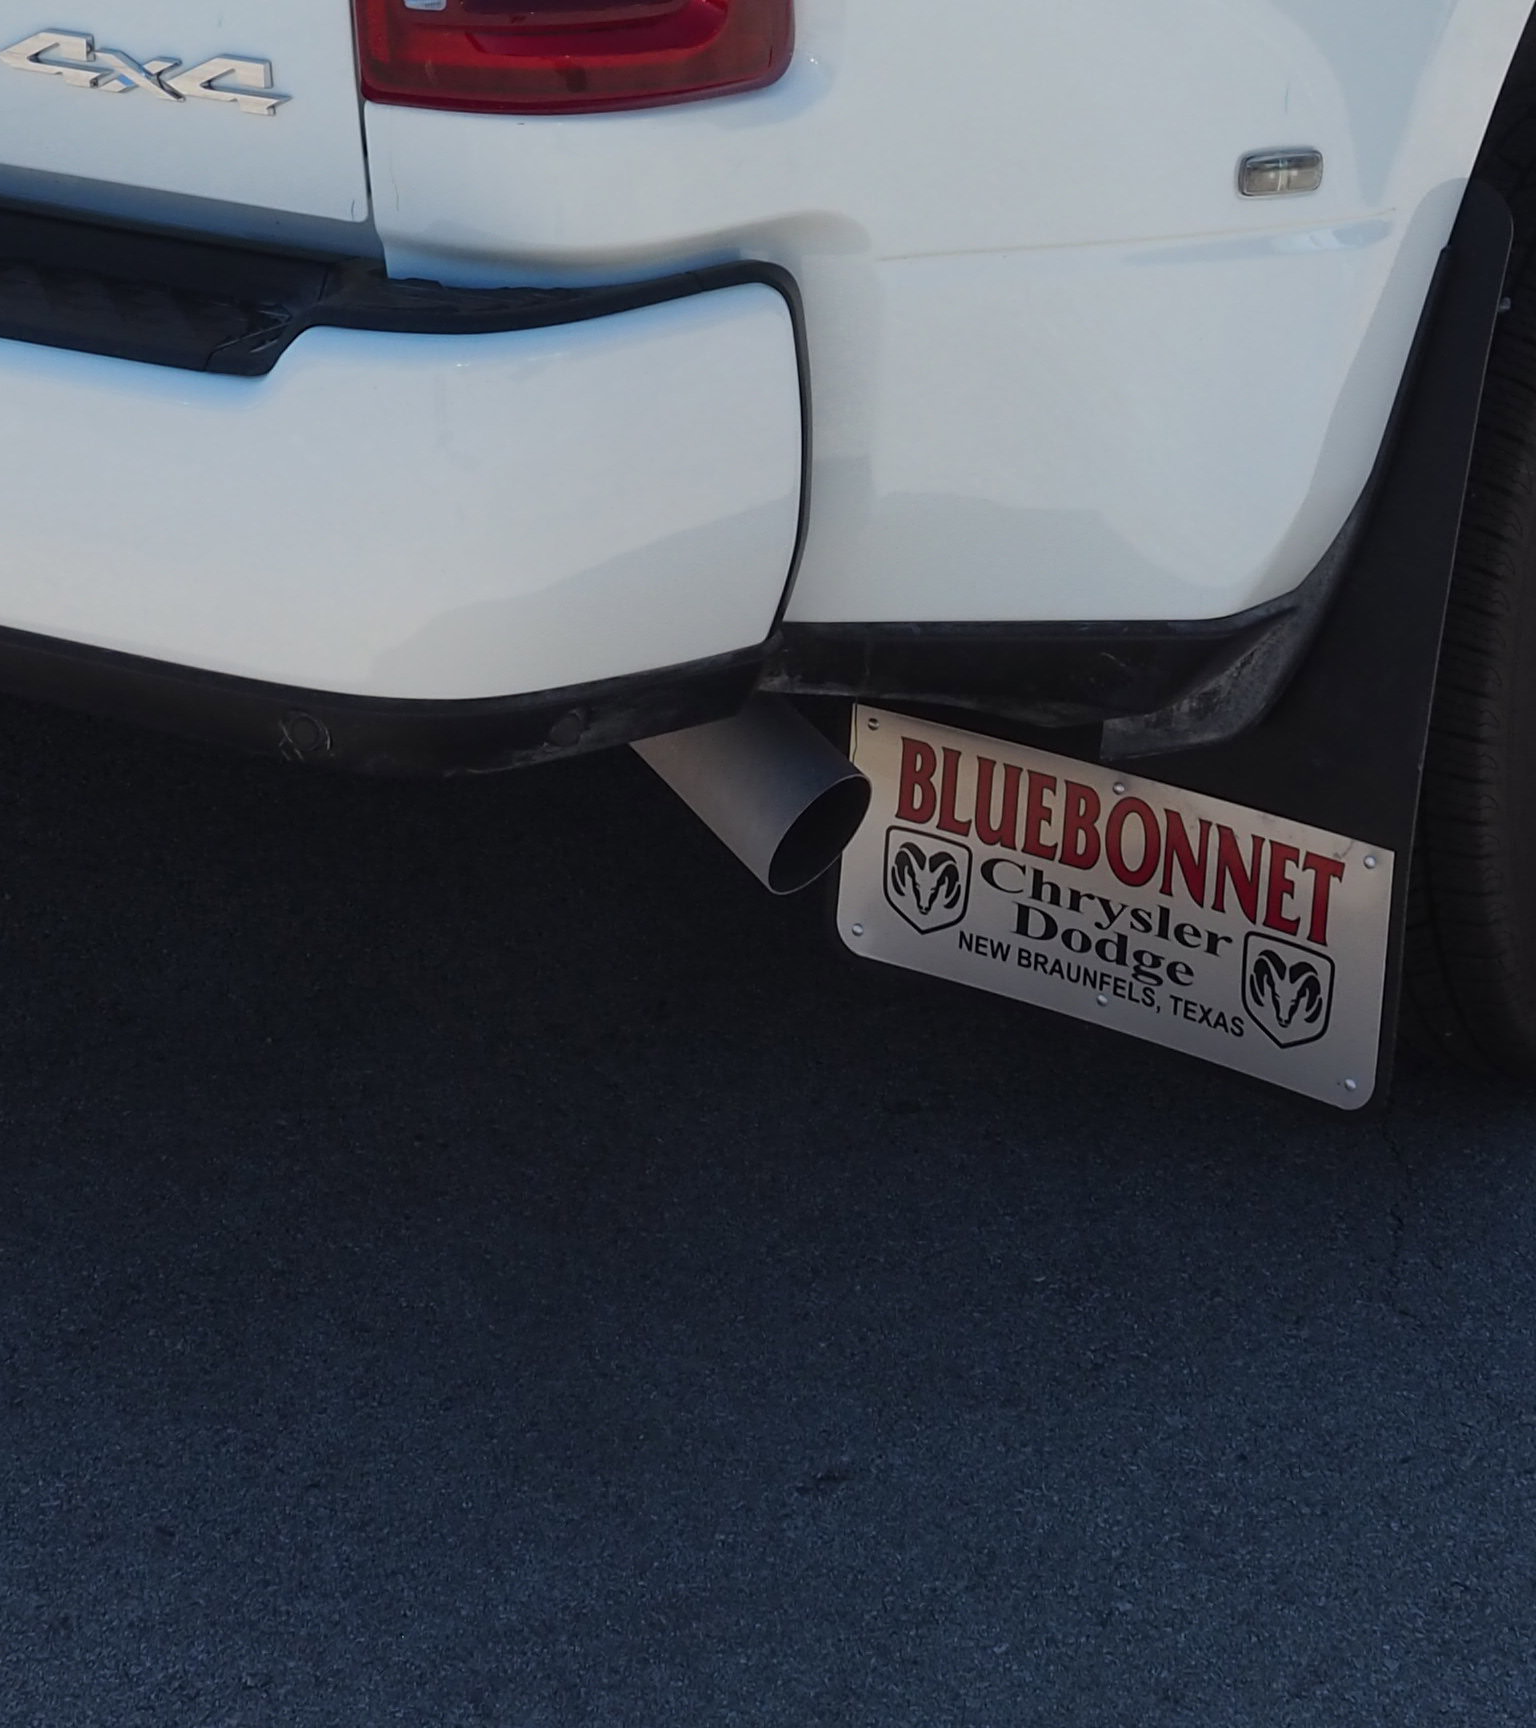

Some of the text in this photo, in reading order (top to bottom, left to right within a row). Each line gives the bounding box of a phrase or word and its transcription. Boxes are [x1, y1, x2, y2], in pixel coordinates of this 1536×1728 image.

[894, 735, 1347, 947] BLUEBONNET
[979, 857, 1234, 958] Chrysler
[1010, 900, 1195, 988] Dodge
[958, 929, 1246, 1038] NEW BRAUNFELS, TEXAS
